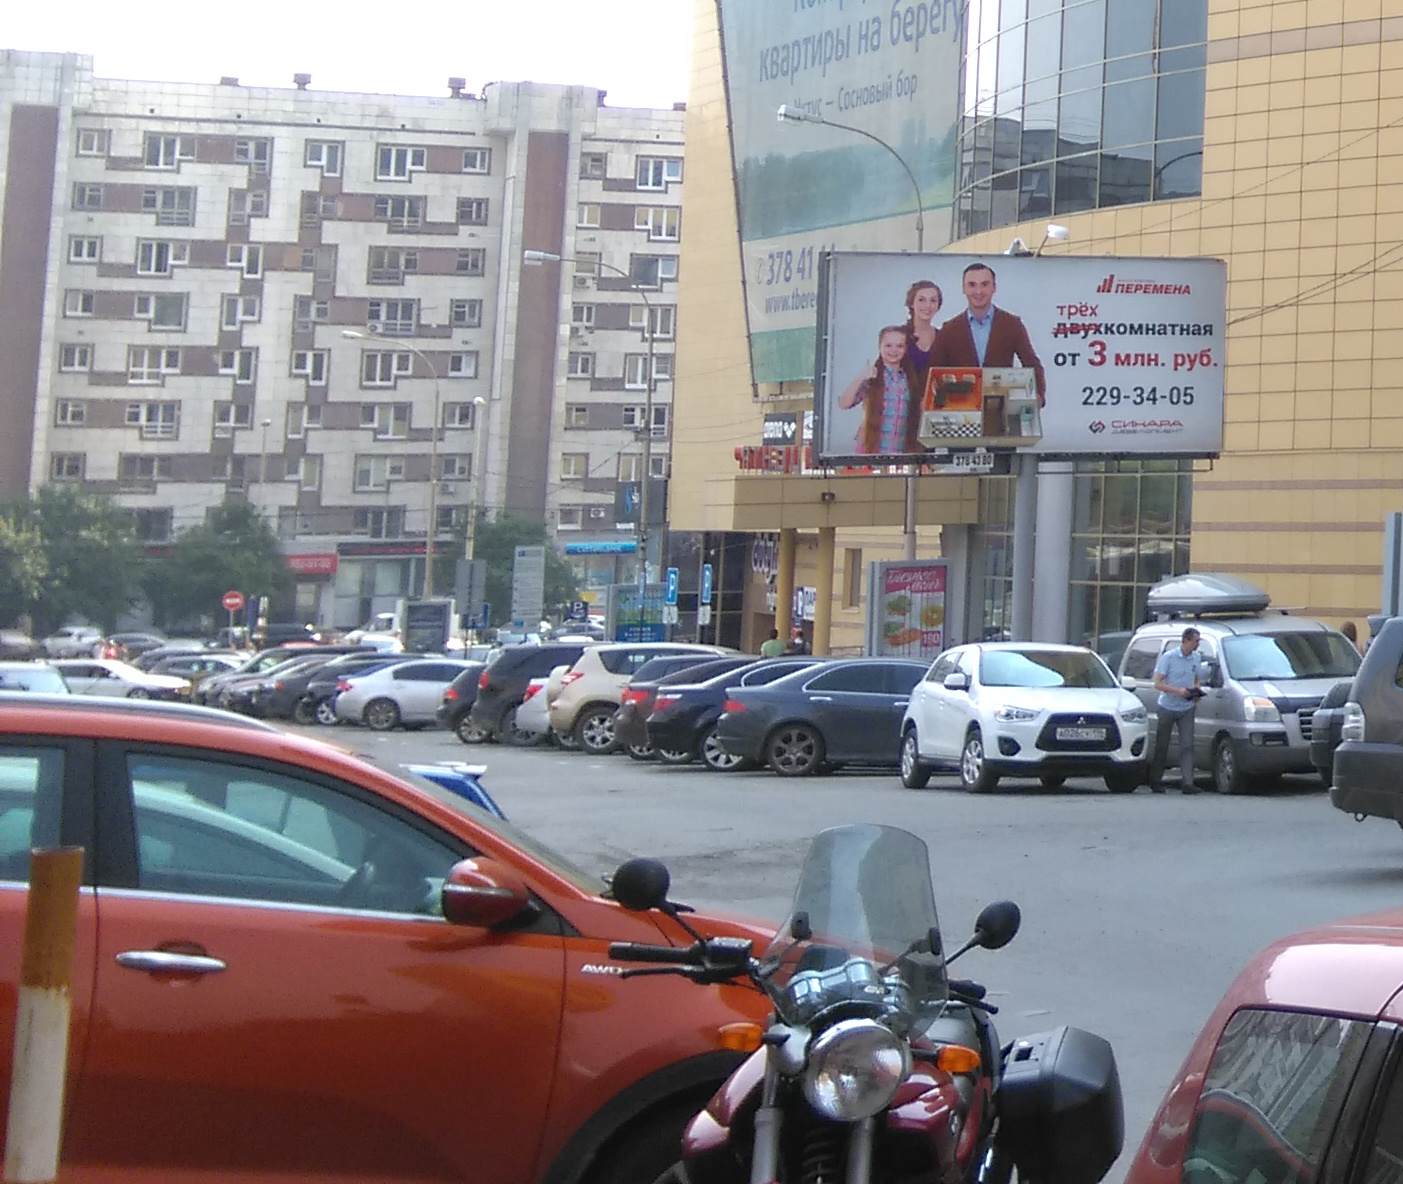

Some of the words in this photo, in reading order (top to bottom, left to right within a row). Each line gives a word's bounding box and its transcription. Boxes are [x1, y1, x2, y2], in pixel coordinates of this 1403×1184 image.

[759, 24, 851, 85] квартиры
[858, 15, 881, 55] на
[838, 74, 893, 112] Сосновый
[896, 69, 918, 102] бор
[766, 250, 792, 286] 378
[1115, 282, 1191, 295] ПЕРЕМЕНА
[1056, 302, 1099, 321] трёх
[1053, 320, 1214, 340] двухкомнатная
[1053, 352, 1081, 367] от
[1087, 341, 1107, 367] 3
[1115, 353, 1167, 367] млн.
[1173, 347, 1219, 371] руб.
[1082, 386, 1195, 406] 229-34-05
[1111, 419, 1184, 428] СИНАРА
[581, 964, 623, 974] AWD
